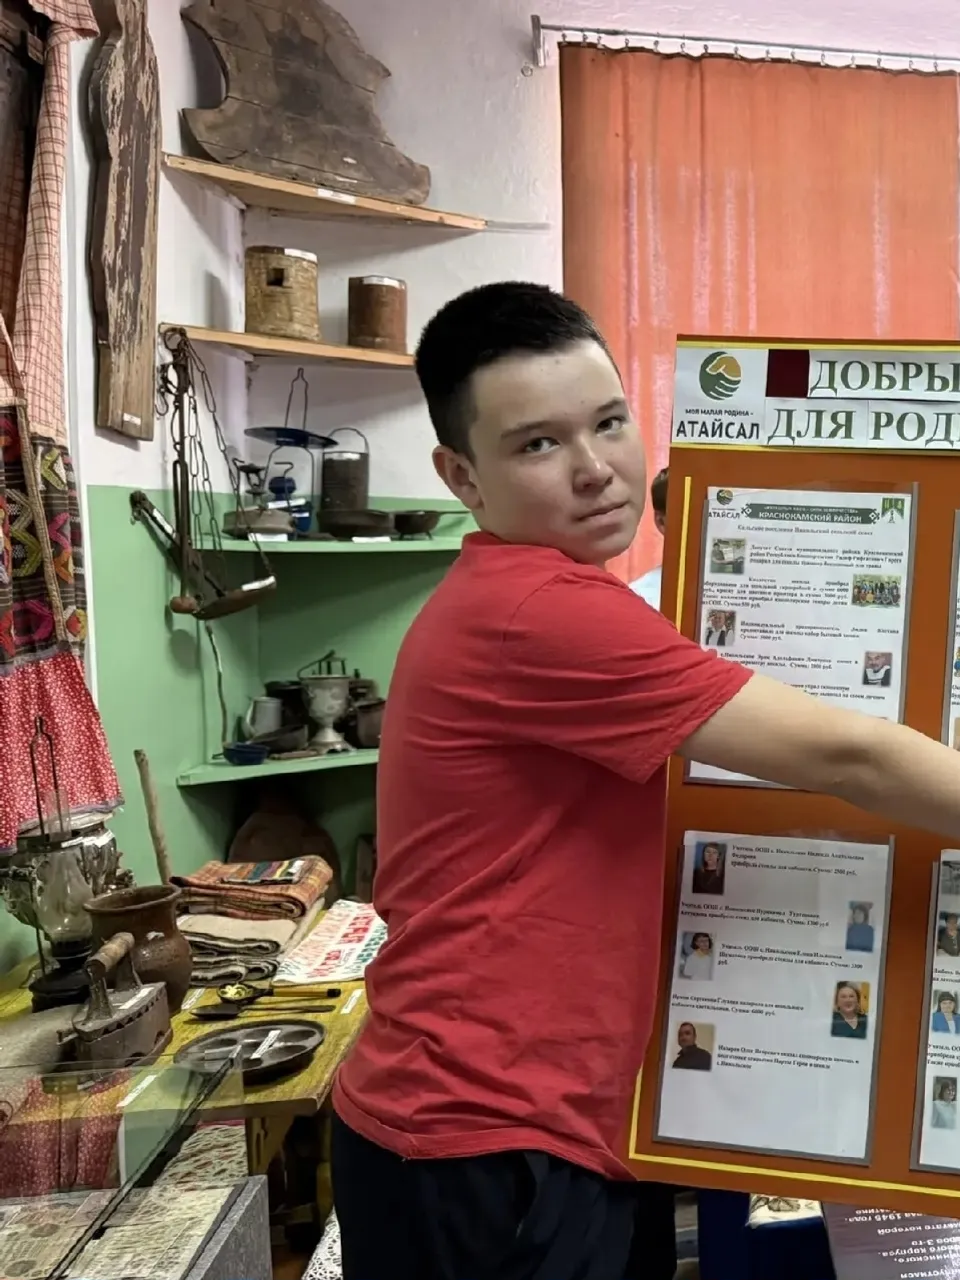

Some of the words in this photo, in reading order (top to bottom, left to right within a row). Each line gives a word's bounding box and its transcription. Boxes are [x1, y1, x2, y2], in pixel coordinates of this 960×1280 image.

[700, 408, 723, 416] МАЛАЯ
[724, 409, 749, 417] РОДИНА
[676, 418, 760, 440] АТАЙСАЛ
[767, 408, 856, 446] ДЛЯ
[759, 512, 832, 523] КРАСНОКАМСКИЙ
[833, 514, 862, 523] РАЙОН
[910, 1238, 933, 1247] 3-го
[876, 1246, 926, 1256] корпуса.
